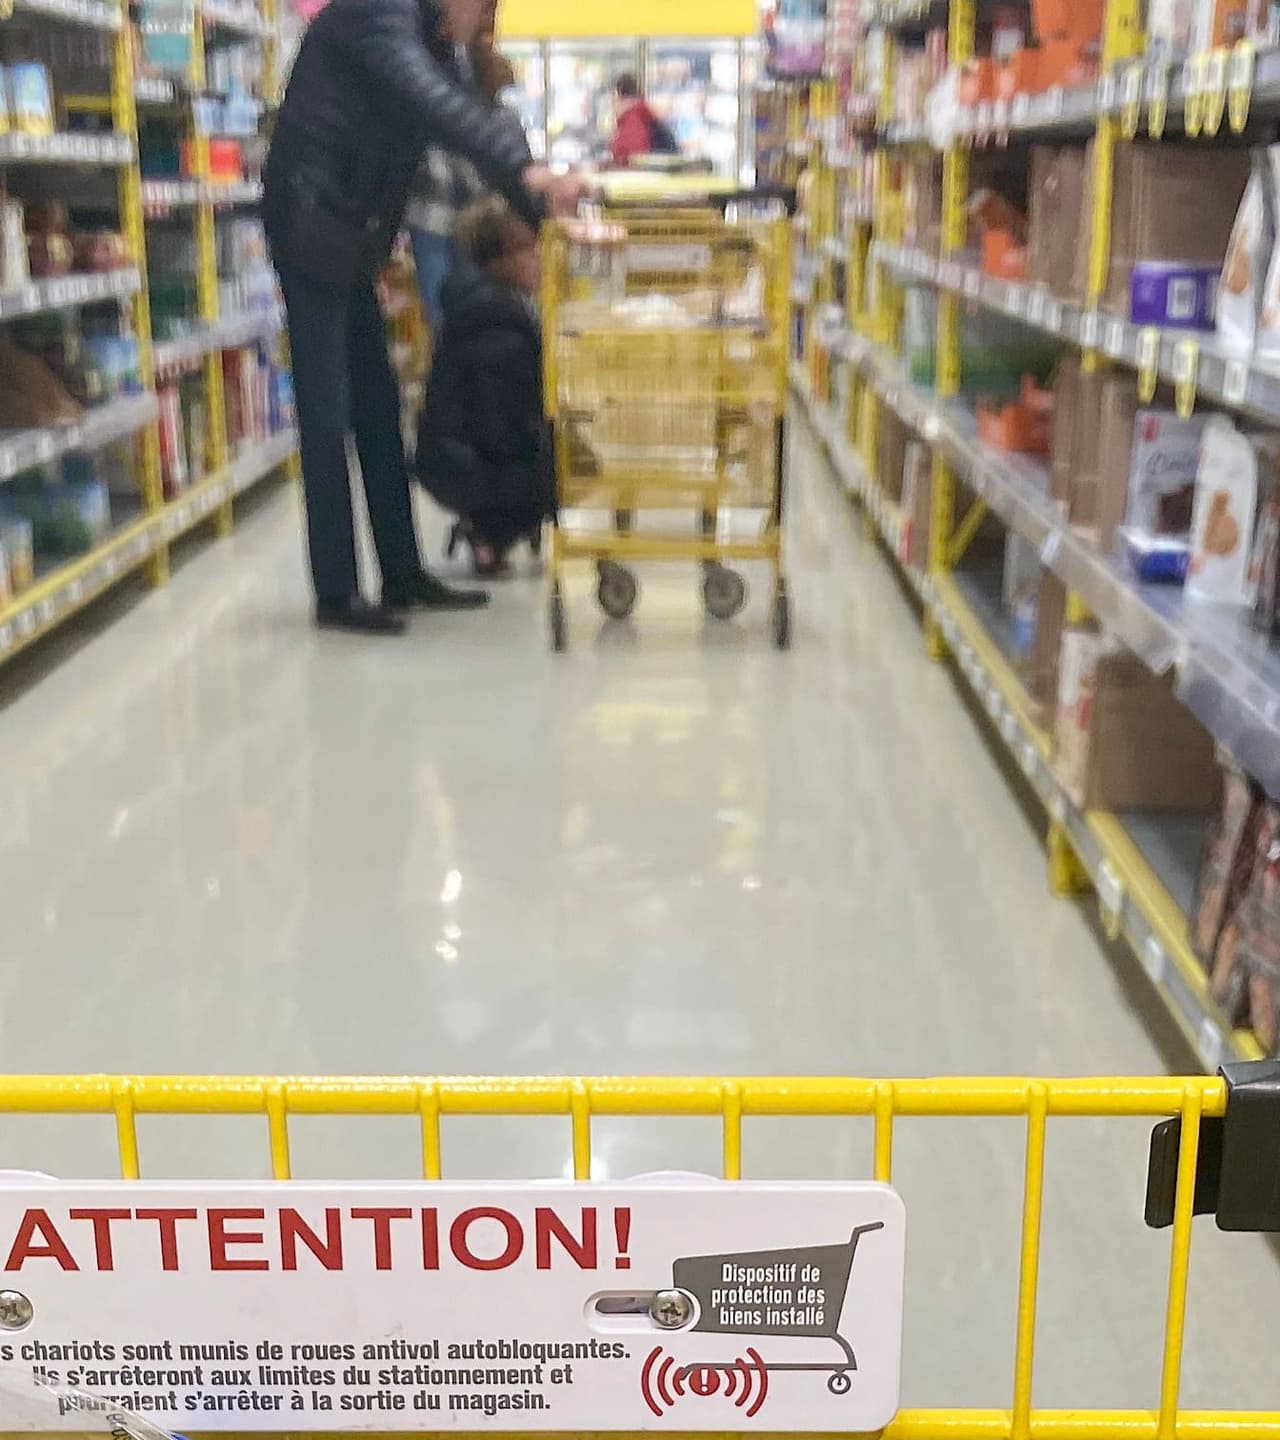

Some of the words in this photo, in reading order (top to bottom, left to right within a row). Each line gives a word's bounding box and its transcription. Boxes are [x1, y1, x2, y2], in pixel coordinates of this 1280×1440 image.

[722, 1263, 797, 1287] Dispositif
[801, 1263, 821, 1283] de
[711, 1285, 793, 1309] protection
[797, 1285, 826, 1304] des
[719, 1306, 763, 1326] biens
[766, 1306, 825, 1326] installé
[20, 1340, 116, 1362] chariots
[122, 1340, 174, 1361] sont
[179, 1340, 250, 1361] munis
[256, 1340, 284, 1361] de
[290, 1342, 356, 1361] roues
[362, 1339, 441, 1361] antivol
[447, 1339, 632, 1364] autobloquantes.
[67, 1364, 205, 1387] s'arrêteront
[211, 1368, 252, 1387] aux
[258, 1365, 337, 1387] limites
[343, 1365, 371, 1386] du
[377, 1364, 544, 1386] stationnement
[550, 1364, 574, 1386] et
[184, 1389, 285, 1412] s'arrêter
[290, 1390, 305, 1412] à
[312, 1390, 334, 1411] la
[340, 1389, 406, 1411] sortie
[413, 1390, 442, 1411] du
[448, 1389, 552, 1415] magasin.
